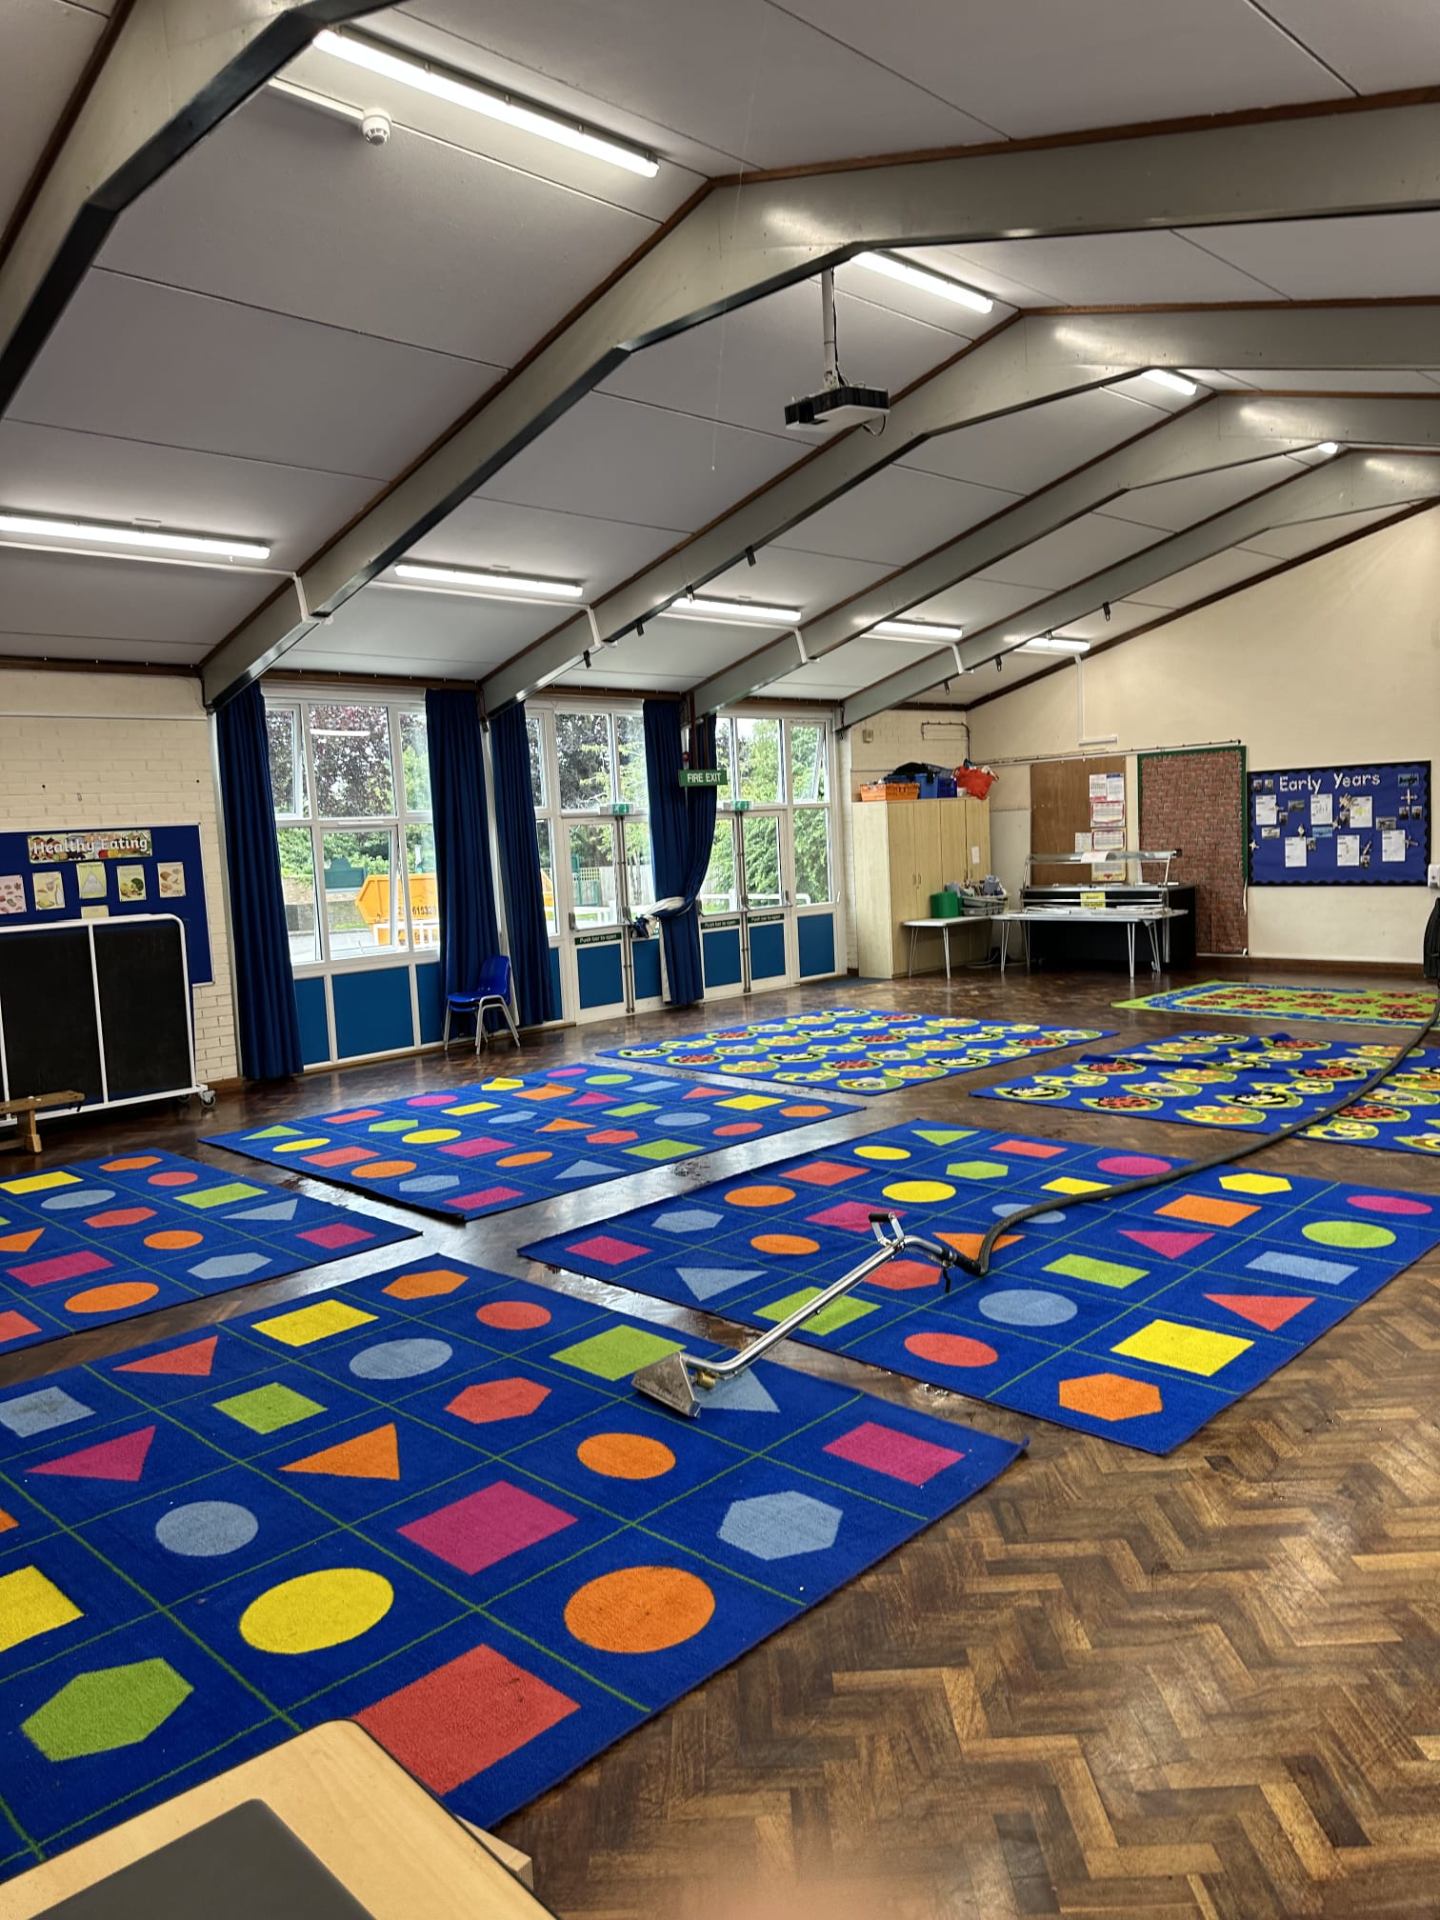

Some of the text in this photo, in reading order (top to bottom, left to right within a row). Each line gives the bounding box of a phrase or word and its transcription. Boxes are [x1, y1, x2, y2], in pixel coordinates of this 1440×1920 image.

[687, 772, 721, 783] FIRE EXIT
[1279, 775, 1321, 795] Early
[1333, 772, 1380, 789] Years
[33, 836, 149, 854] Healthy Eating
